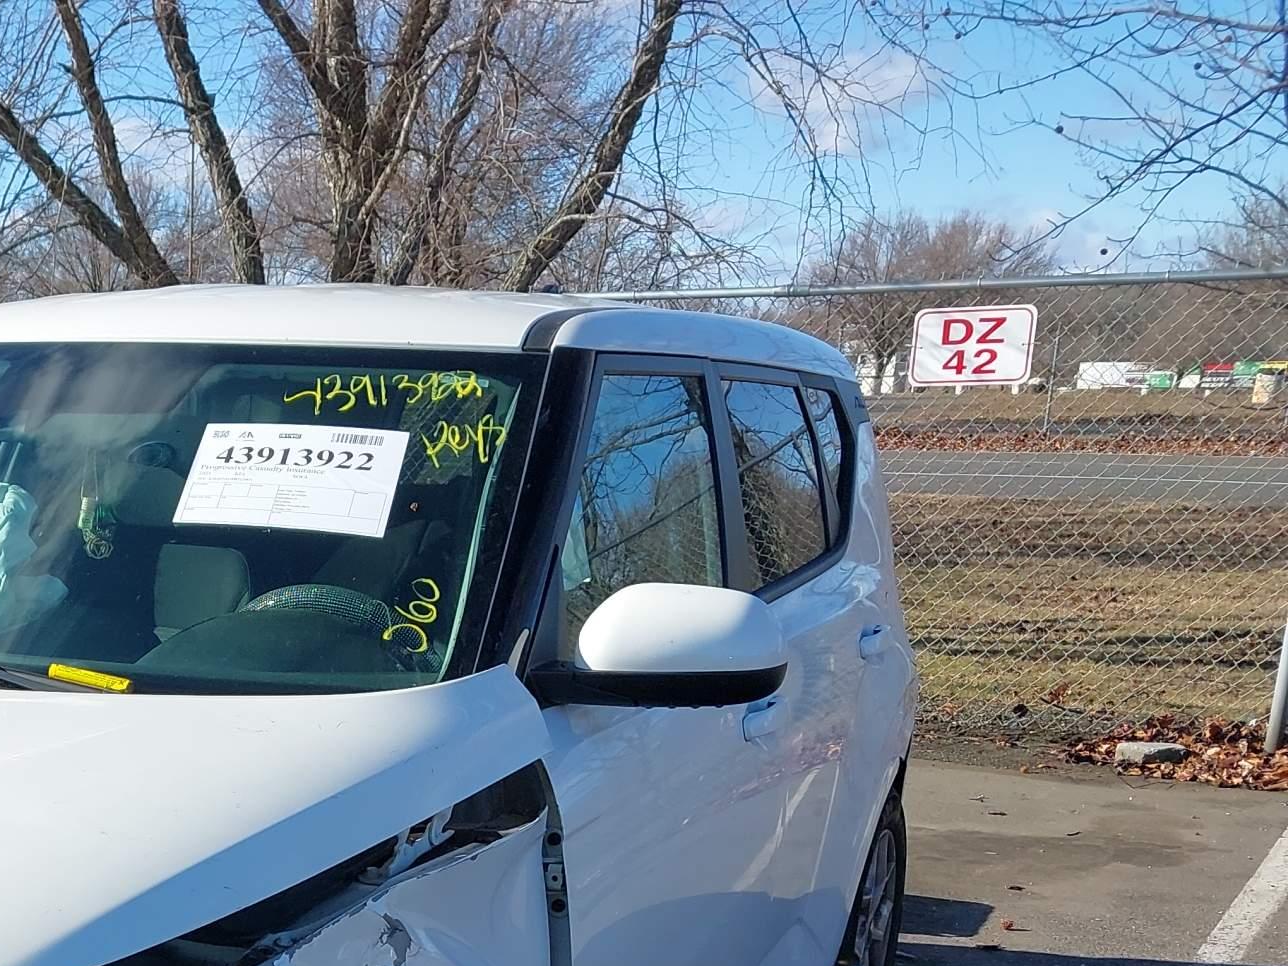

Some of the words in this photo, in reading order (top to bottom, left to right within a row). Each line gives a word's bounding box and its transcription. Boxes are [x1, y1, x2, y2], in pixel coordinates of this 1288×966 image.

[941, 316, 1008, 346] DZ
[942, 348, 998, 376] 42
[215, 445, 375, 472] 43913922
